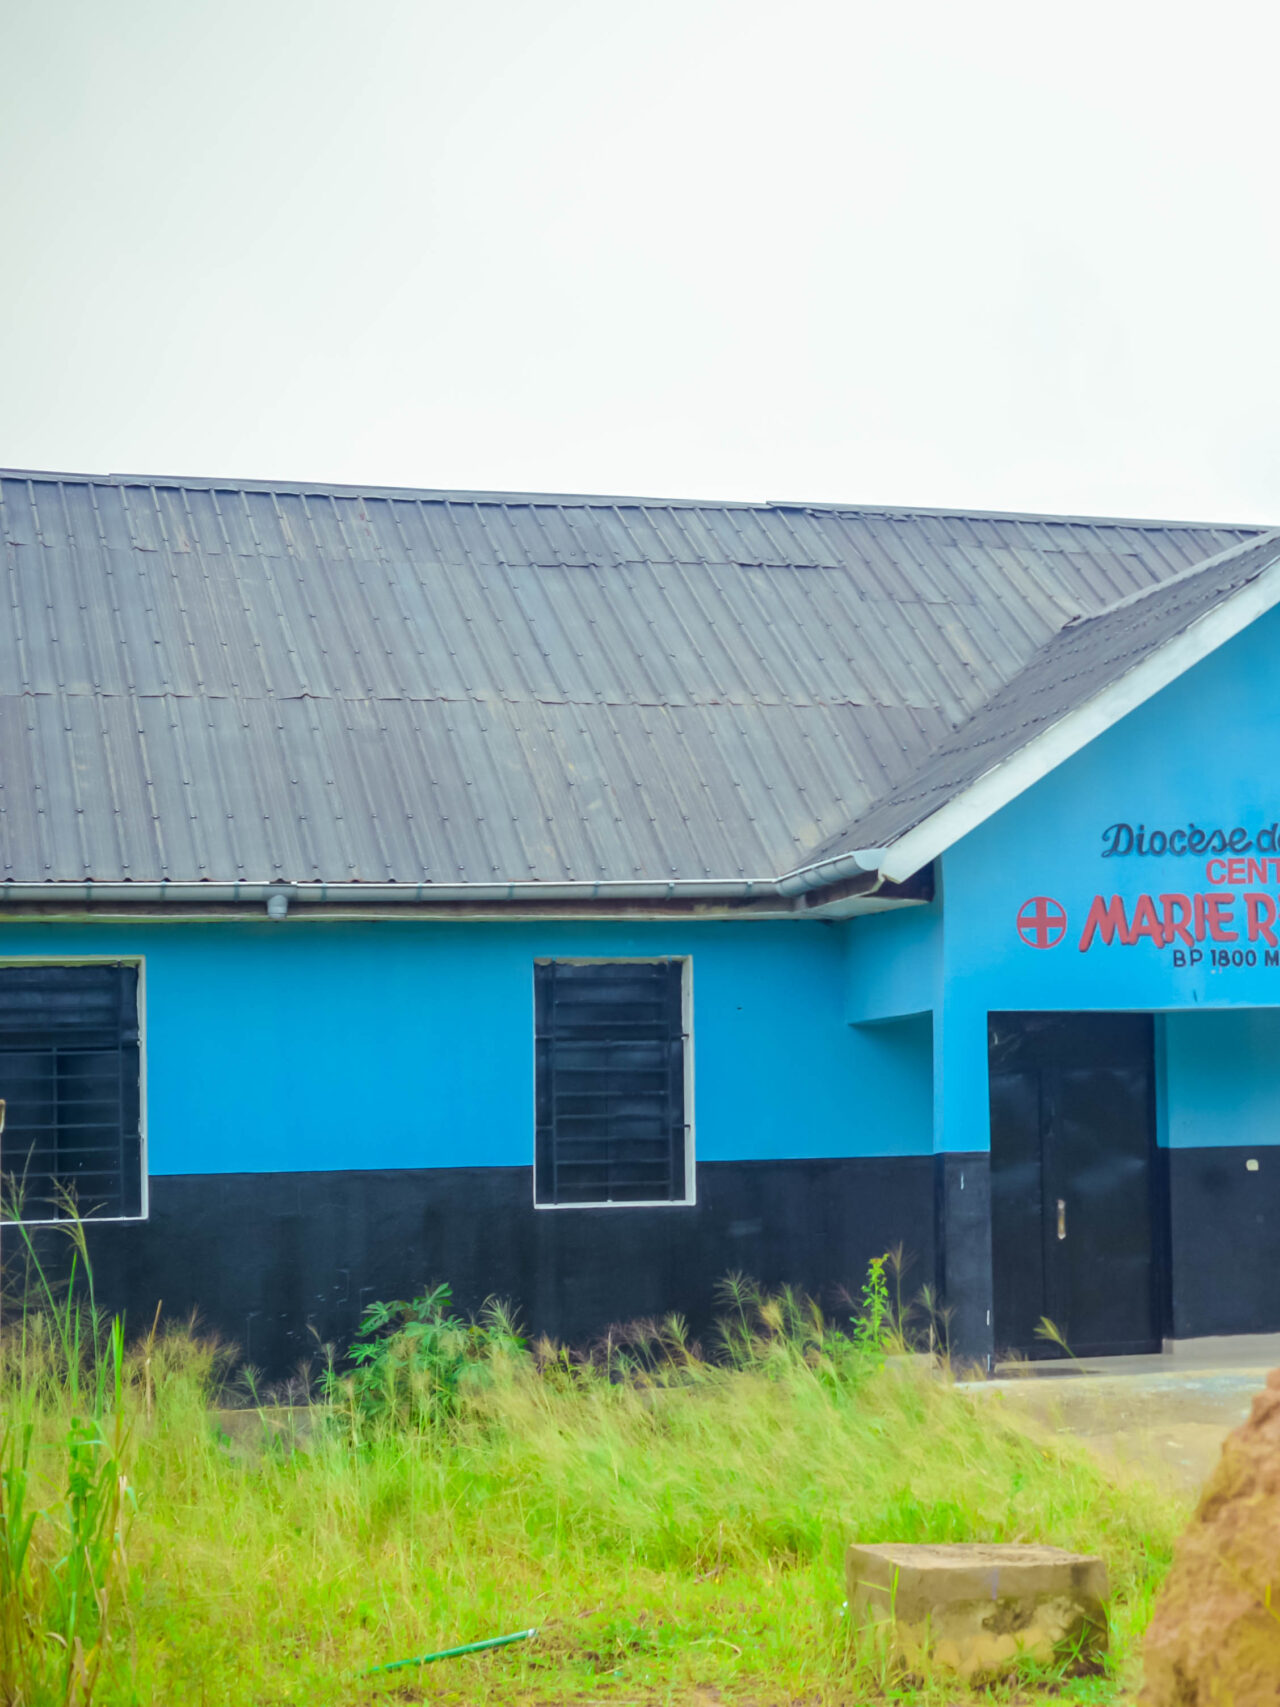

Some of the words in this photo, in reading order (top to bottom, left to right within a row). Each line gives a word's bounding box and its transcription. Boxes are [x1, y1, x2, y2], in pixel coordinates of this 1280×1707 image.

[1100, 823, 1254, 858] Diocèse
[1078, 892, 1239, 953] MARIE
[1173, 950, 1203, 967] BP
[1210, 949, 1257, 967] 1800
